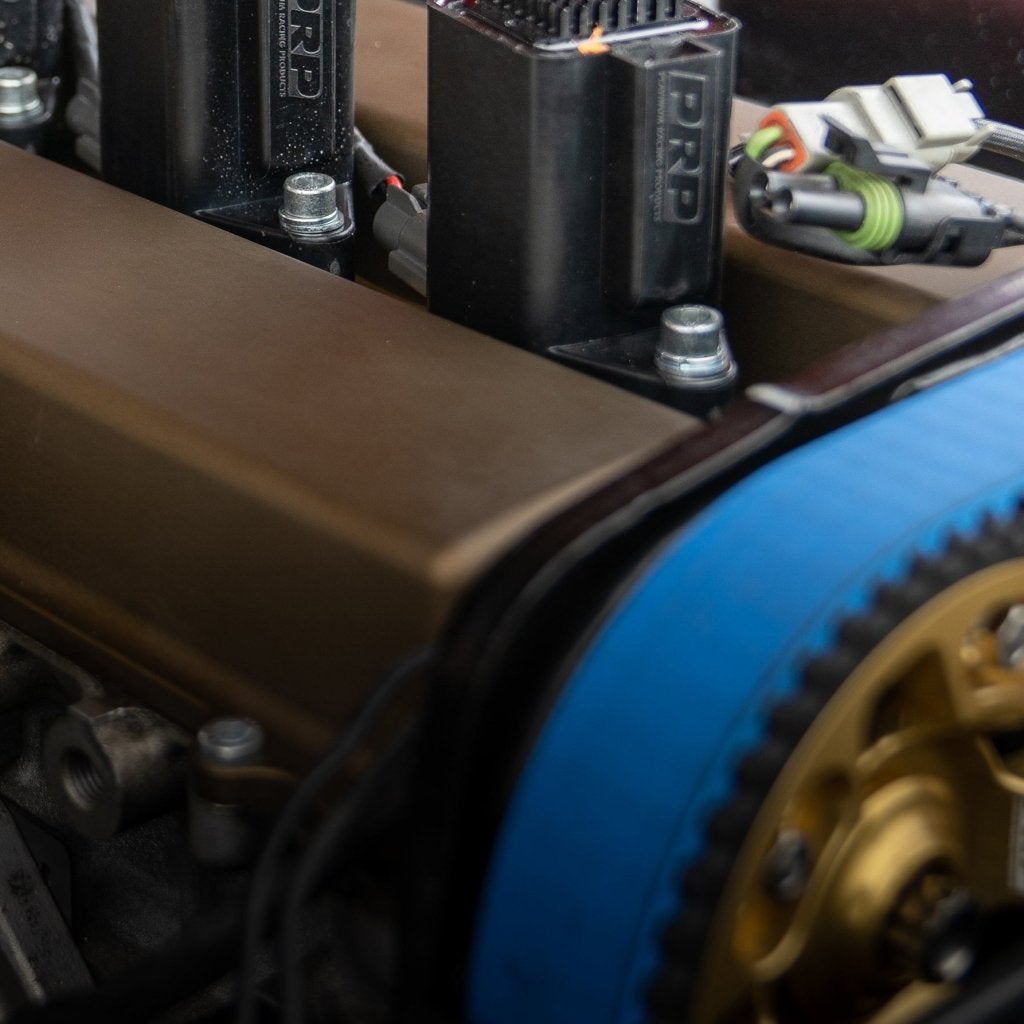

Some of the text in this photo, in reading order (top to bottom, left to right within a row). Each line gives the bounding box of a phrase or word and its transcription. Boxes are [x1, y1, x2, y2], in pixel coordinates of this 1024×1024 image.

[278, 12, 286, 48] RACING
[279, 50, 287, 98] PRODUCTS
[663, 70, 707, 224] PRP
